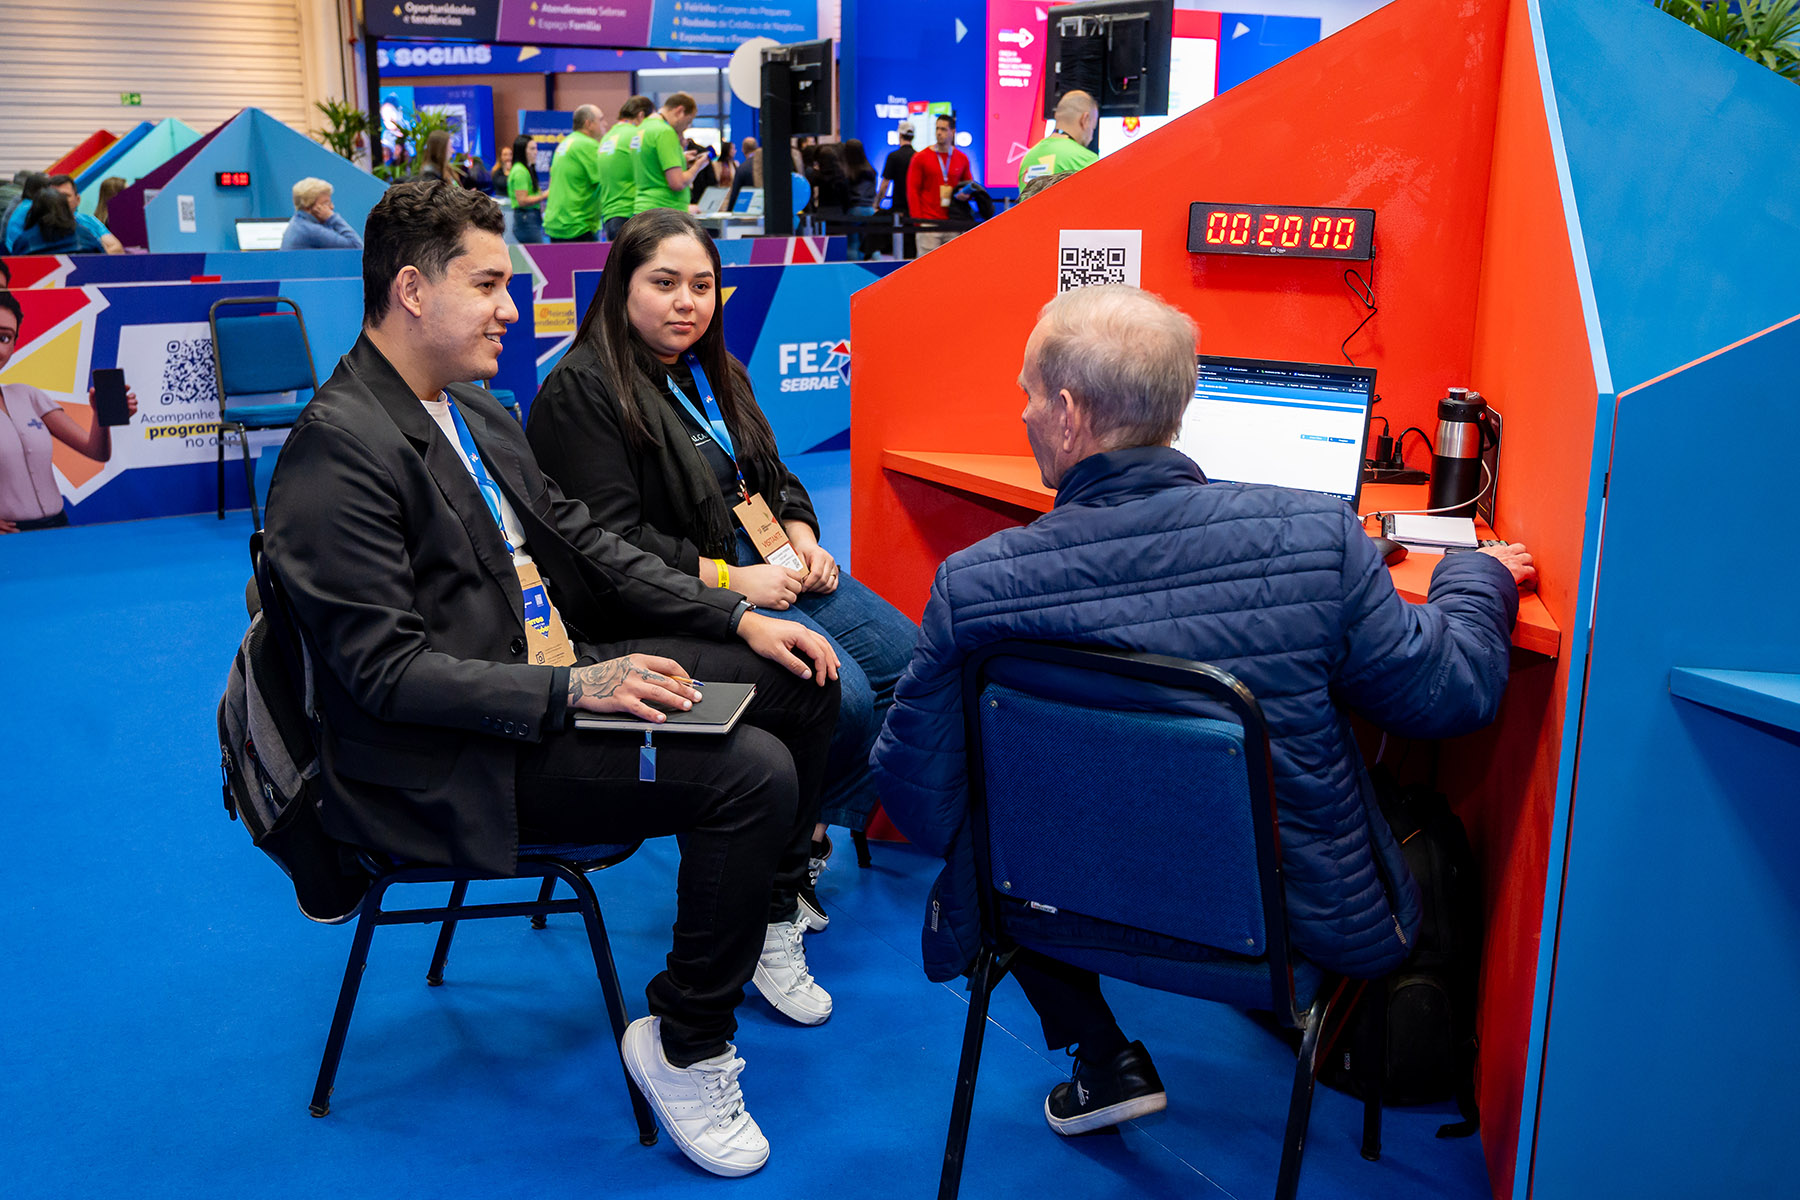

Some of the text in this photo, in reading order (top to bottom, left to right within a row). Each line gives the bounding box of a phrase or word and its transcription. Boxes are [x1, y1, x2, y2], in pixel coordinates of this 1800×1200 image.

[394, 45, 492, 67] SOCIAIS
[780, 375, 840, 393] SEBRAE
[140, 409, 216, 424] Acompanhe
[185, 438, 205, 448] no
